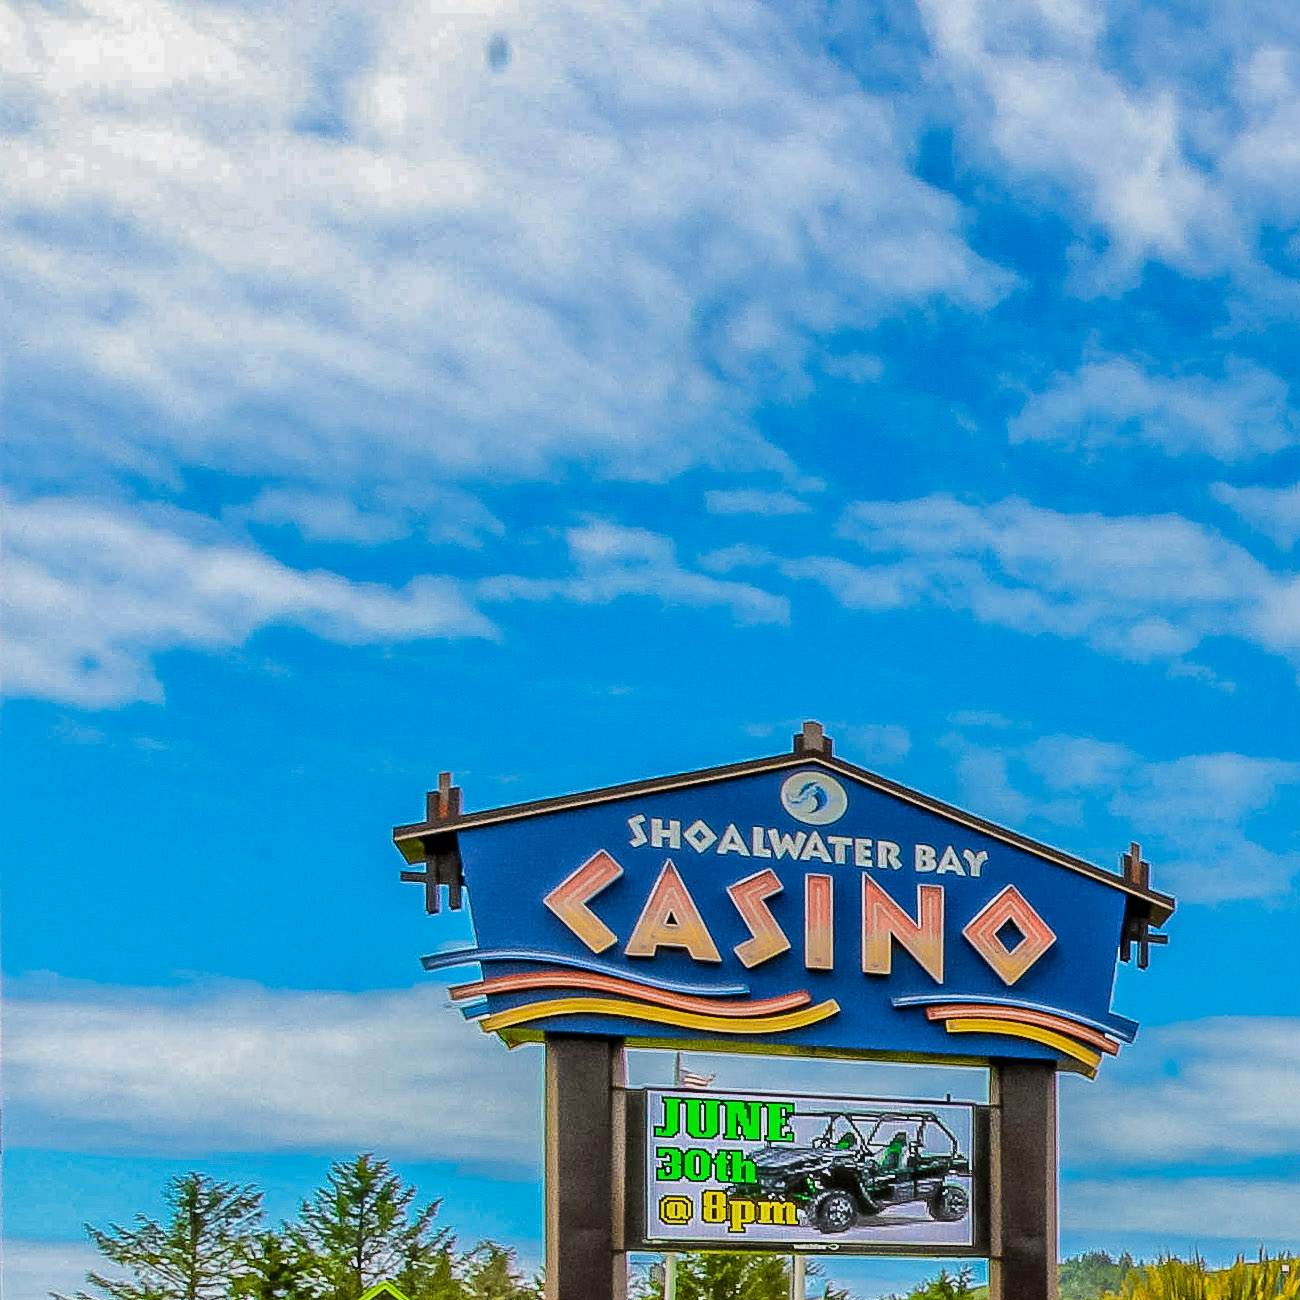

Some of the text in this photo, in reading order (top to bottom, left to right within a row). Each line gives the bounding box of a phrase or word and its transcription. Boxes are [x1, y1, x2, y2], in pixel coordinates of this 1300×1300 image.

[627, 813, 989, 878] SHOALWATER BAY
[543, 849, 1057, 986] CASINO
[653, 1096, 795, 1143] JUNE
[655, 1146, 758, 1184] 30th
[658, 1190, 800, 1233] @ 8pm
